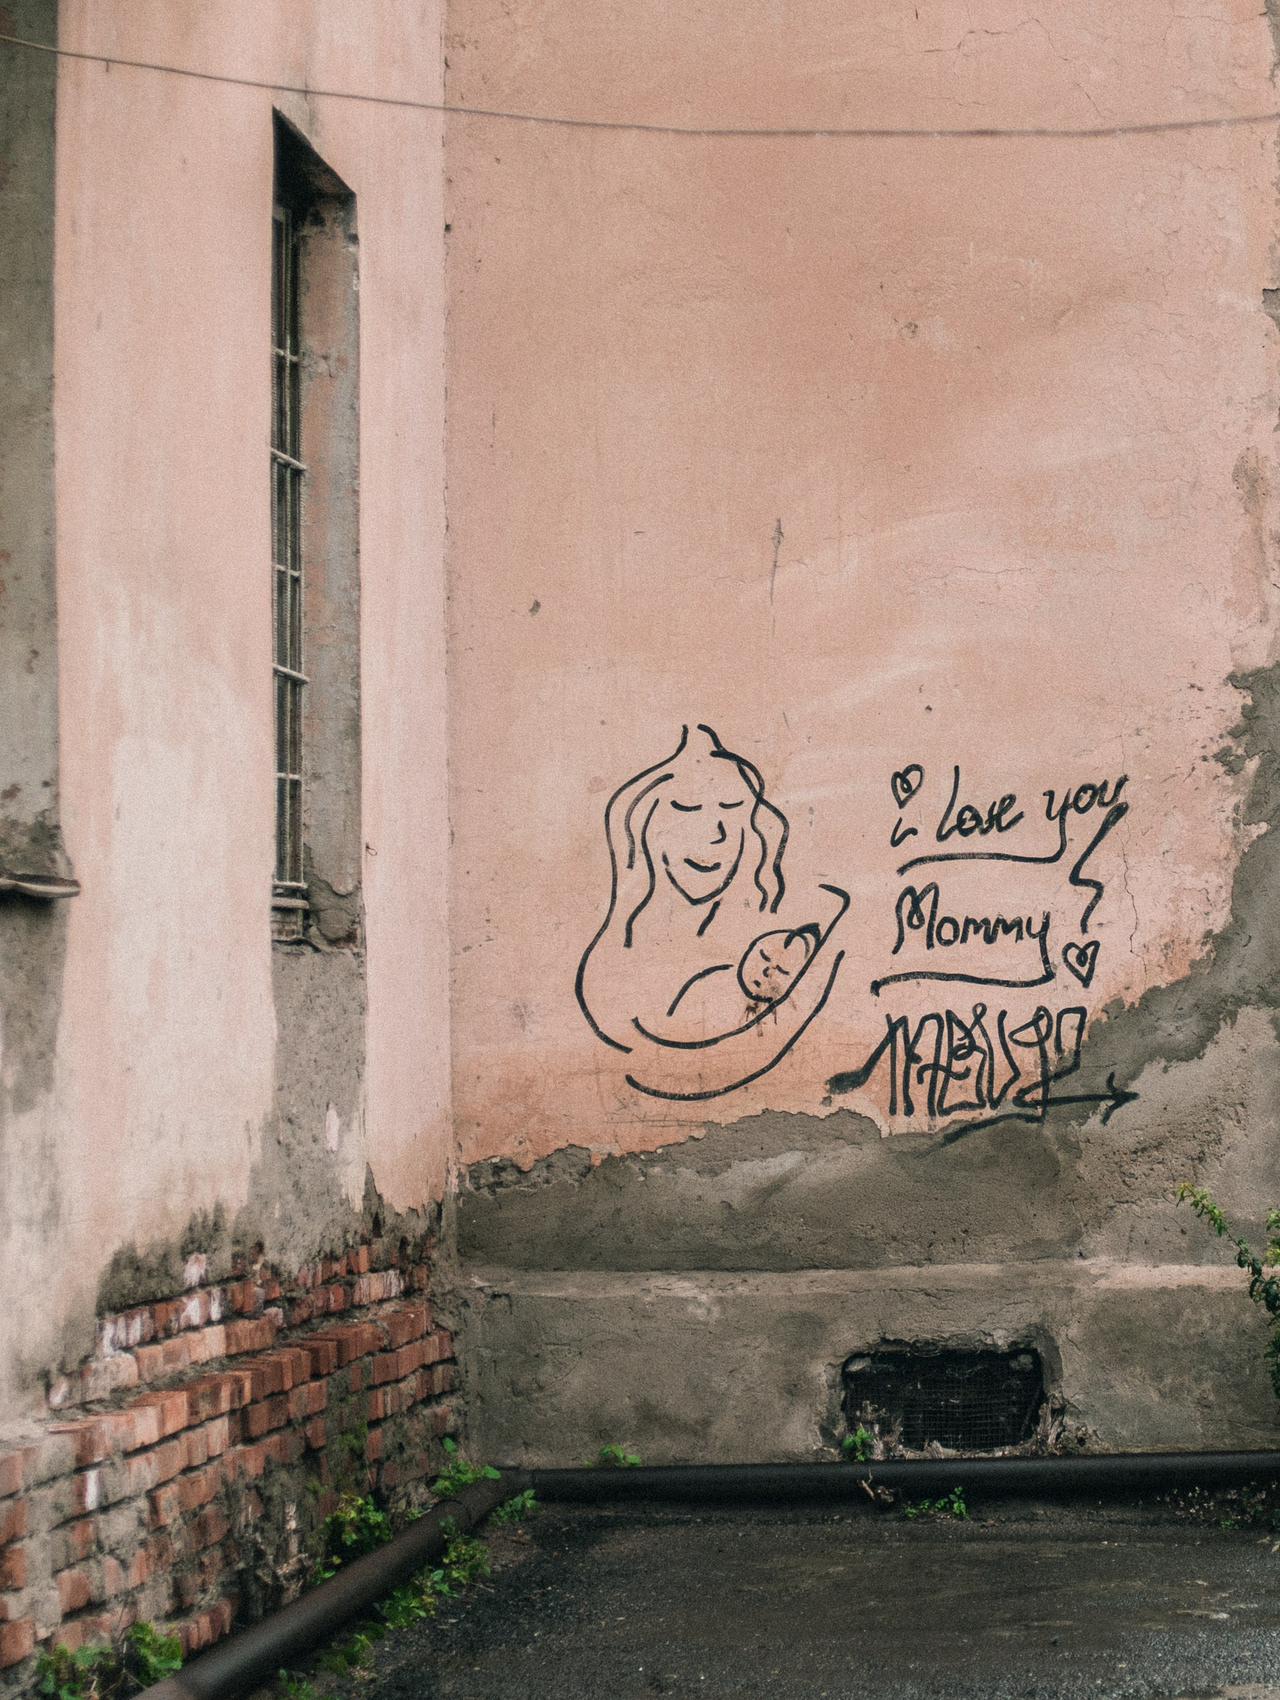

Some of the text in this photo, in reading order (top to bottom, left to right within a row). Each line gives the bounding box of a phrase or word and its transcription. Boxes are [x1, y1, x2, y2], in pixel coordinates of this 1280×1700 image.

[936, 765, 1024, 842] Love
[1043, 774, 1129, 863] you
[891, 881, 1055, 987] Mommy
